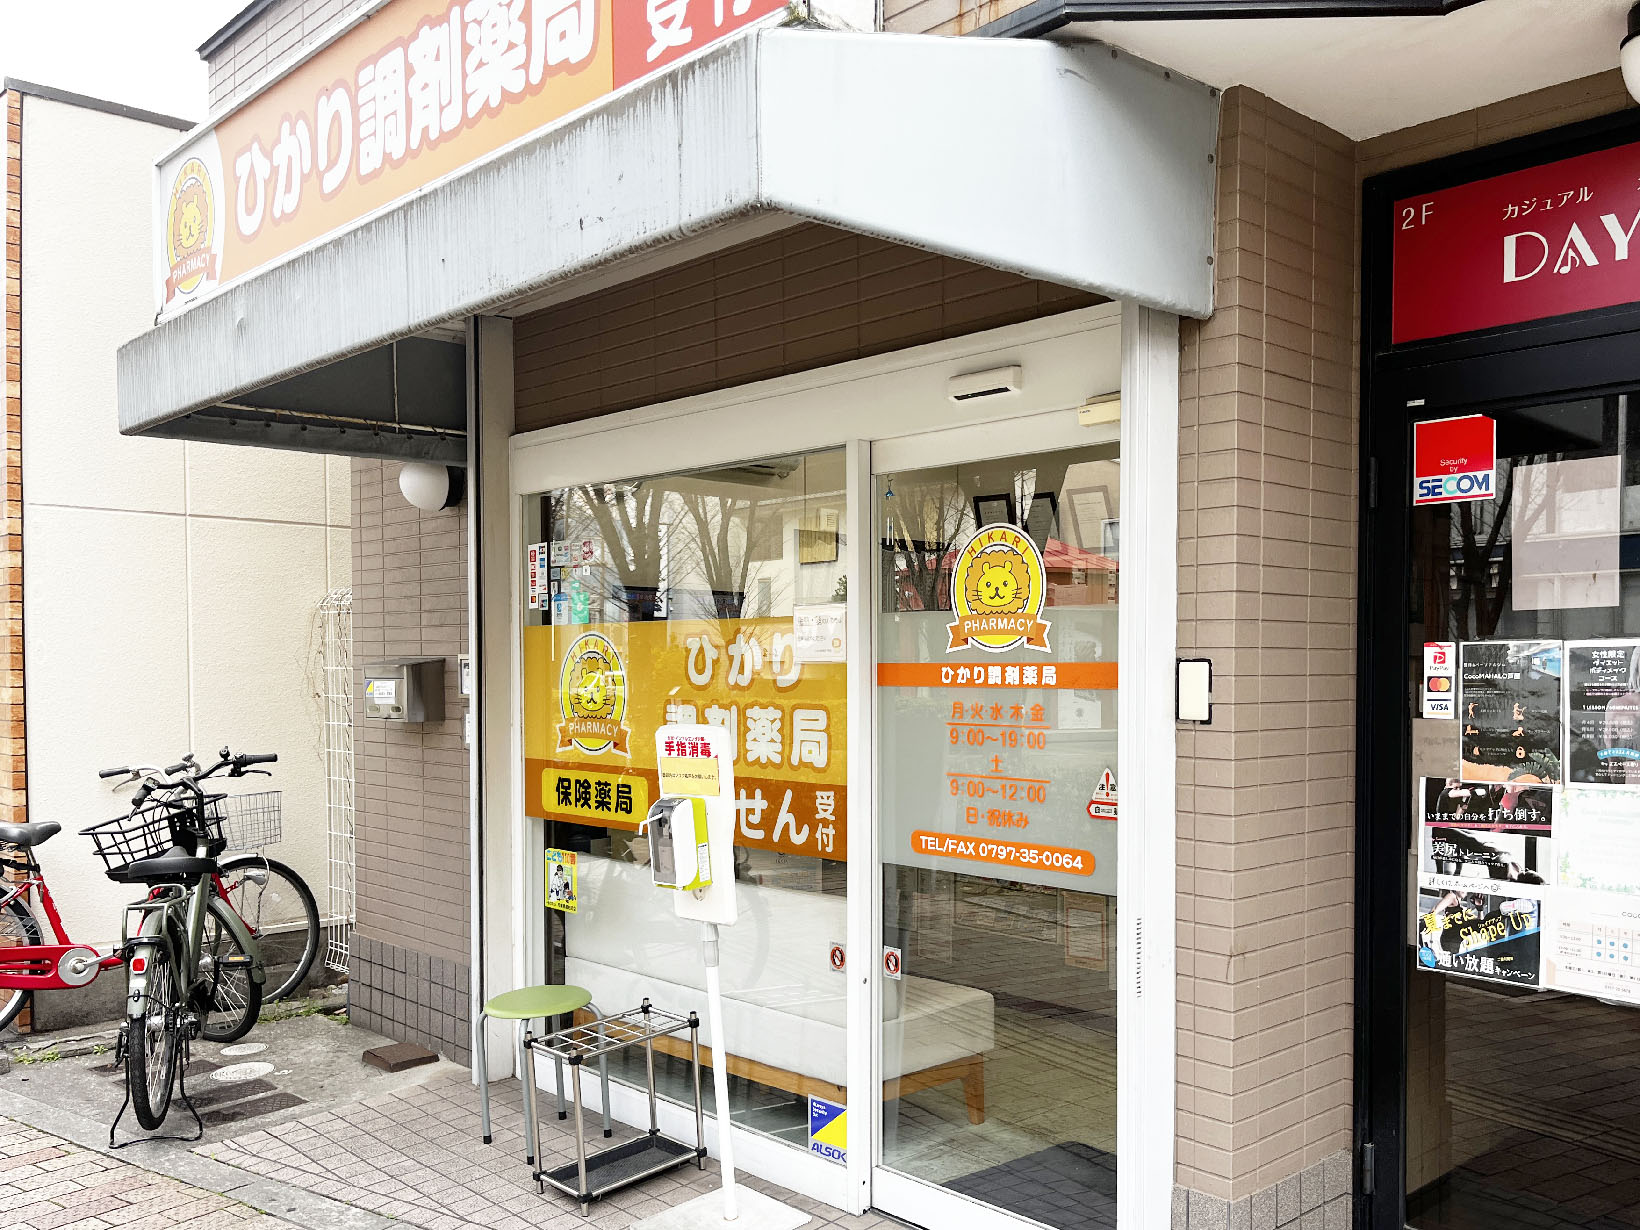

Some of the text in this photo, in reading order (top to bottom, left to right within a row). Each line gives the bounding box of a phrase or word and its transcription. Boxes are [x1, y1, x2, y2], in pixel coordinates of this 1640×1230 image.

[236, 0, 594, 235] ひかり調剤薬局
[1402, 202, 1434, 230] 2F
[1503, 186, 1594, 220] カジュアル
[172, 253, 211, 283] PHARMACY
[1440, 458, 1468, 467] Security
[1418, 473, 1490, 498] SECOM
[967, 530, 1030, 558] HIKARI
[963, 617, 1034, 634] PHARMACY
[570, 639, 616, 663] HIKARI
[686, 632, 801, 688] ひかり
[941, 665, 1057, 686] ひかり調剤薬局
[1430, 703, 1449, 711] VISA
[569, 721, 619, 737] PHARMACY
[664, 740, 712, 758] 手指消毒
[990, 754, 1004, 773] 土
[555, 776, 633, 815] 保険薬局
[815, 790, 836, 853] 受付
[919, 835, 1084, 871] TEL/FAX 0797-35-0064
[1459, 920, 1507, 949] Shape
[811, 1142, 847, 1163] ALSOK
